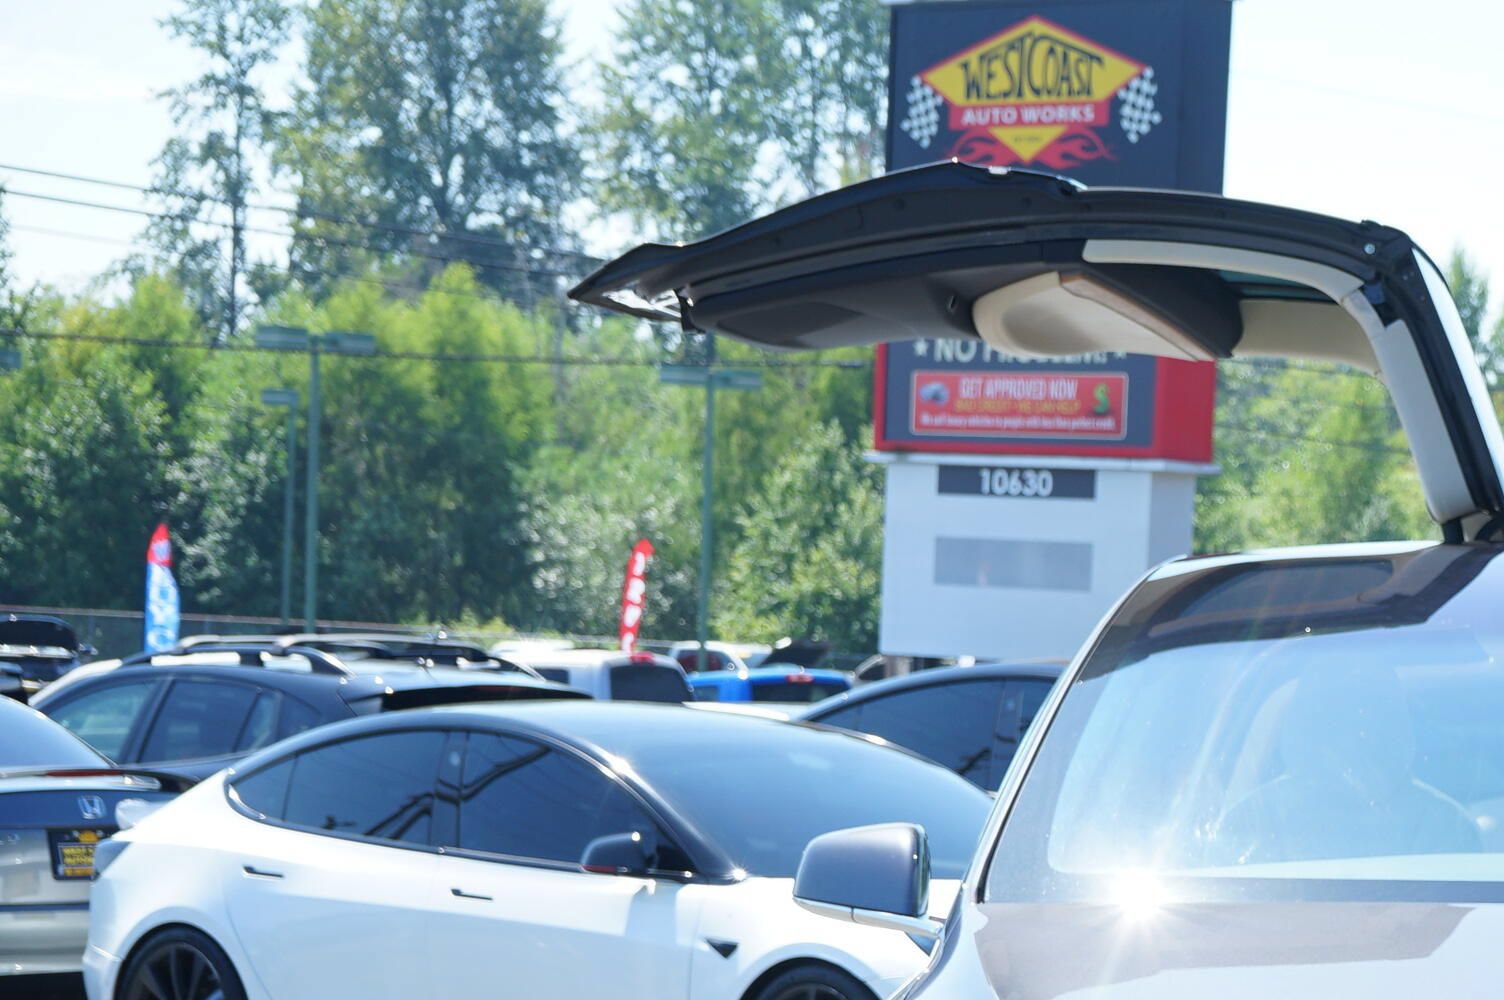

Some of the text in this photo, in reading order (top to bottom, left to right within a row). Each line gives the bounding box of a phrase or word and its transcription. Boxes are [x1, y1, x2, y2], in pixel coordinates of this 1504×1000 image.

[962, 104, 1095, 126] AUTO WORKS
[980, 468, 1053, 496] 10630
